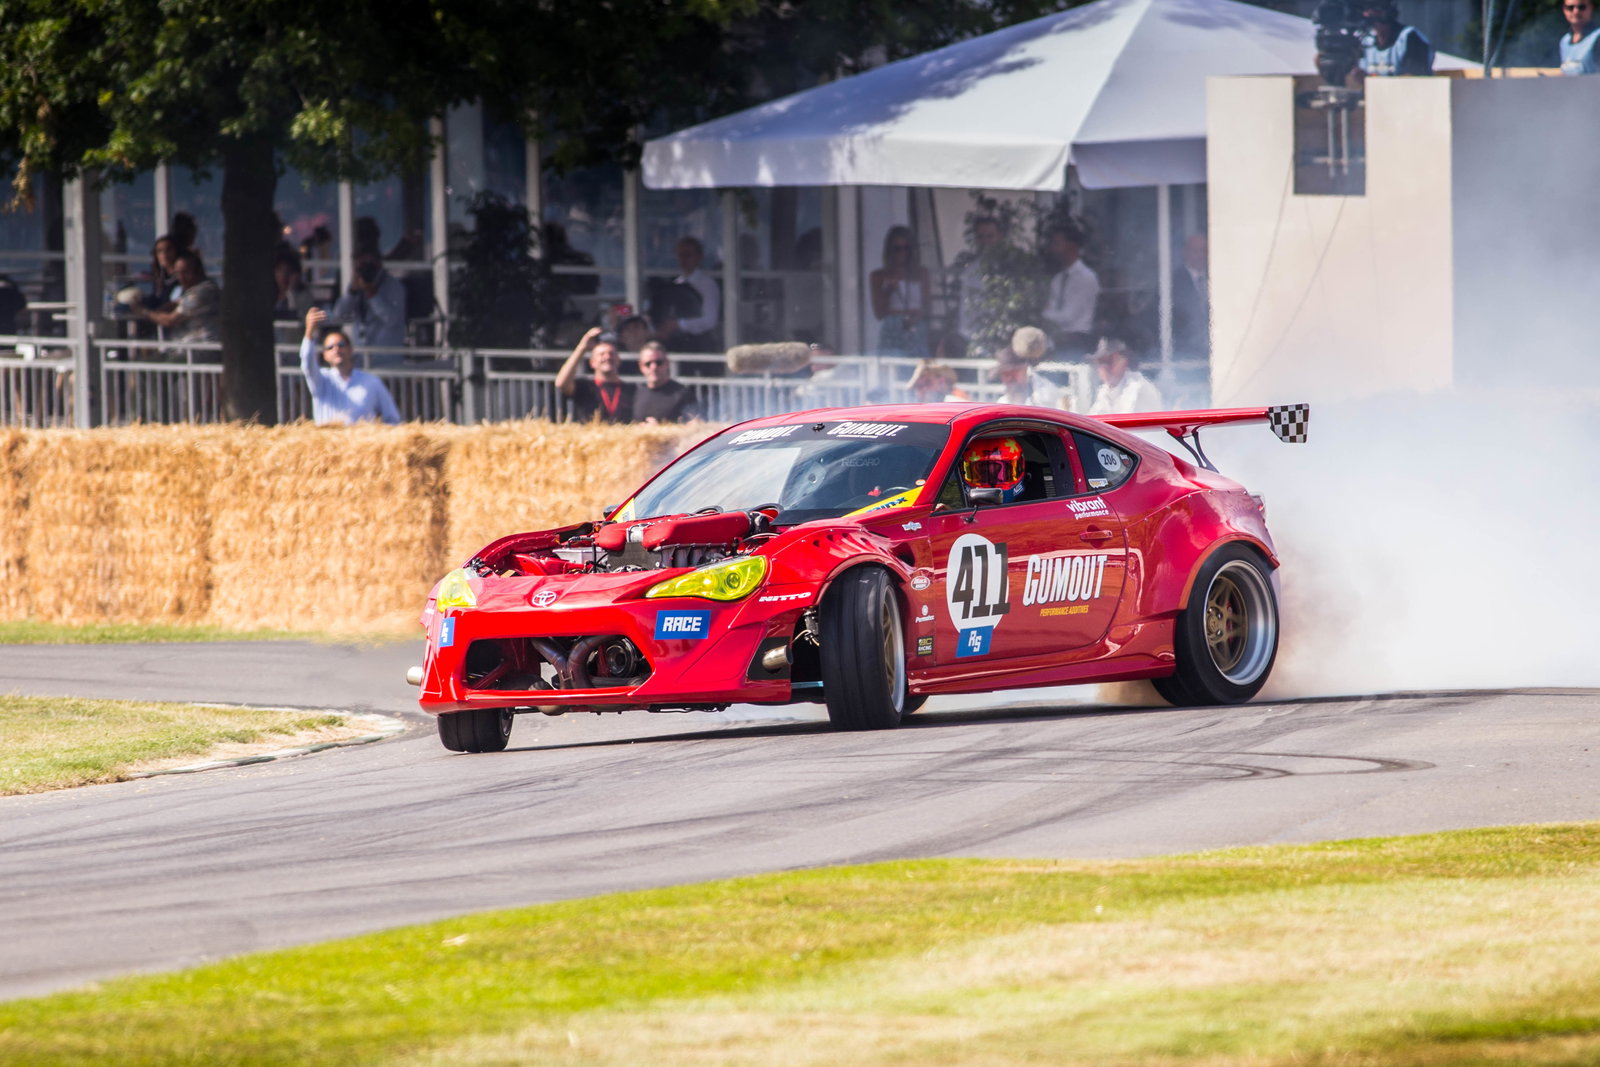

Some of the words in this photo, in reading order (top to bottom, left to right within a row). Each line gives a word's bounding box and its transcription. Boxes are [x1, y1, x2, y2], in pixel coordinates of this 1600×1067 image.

[827, 422, 908, 436] GUMOUT
[841, 457, 880, 467] RECARO
[1101, 454, 1117, 466] 206
[1066, 497, 1107, 513] vibrant
[1074, 509, 1109, 520] performance
[952, 542, 1010, 619] 411
[1022, 554, 1107, 606] GUMOUT
[758, 592, 812, 602] NITTO
[662, 616, 702, 632] RACE
[968, 630, 982, 652] RS
